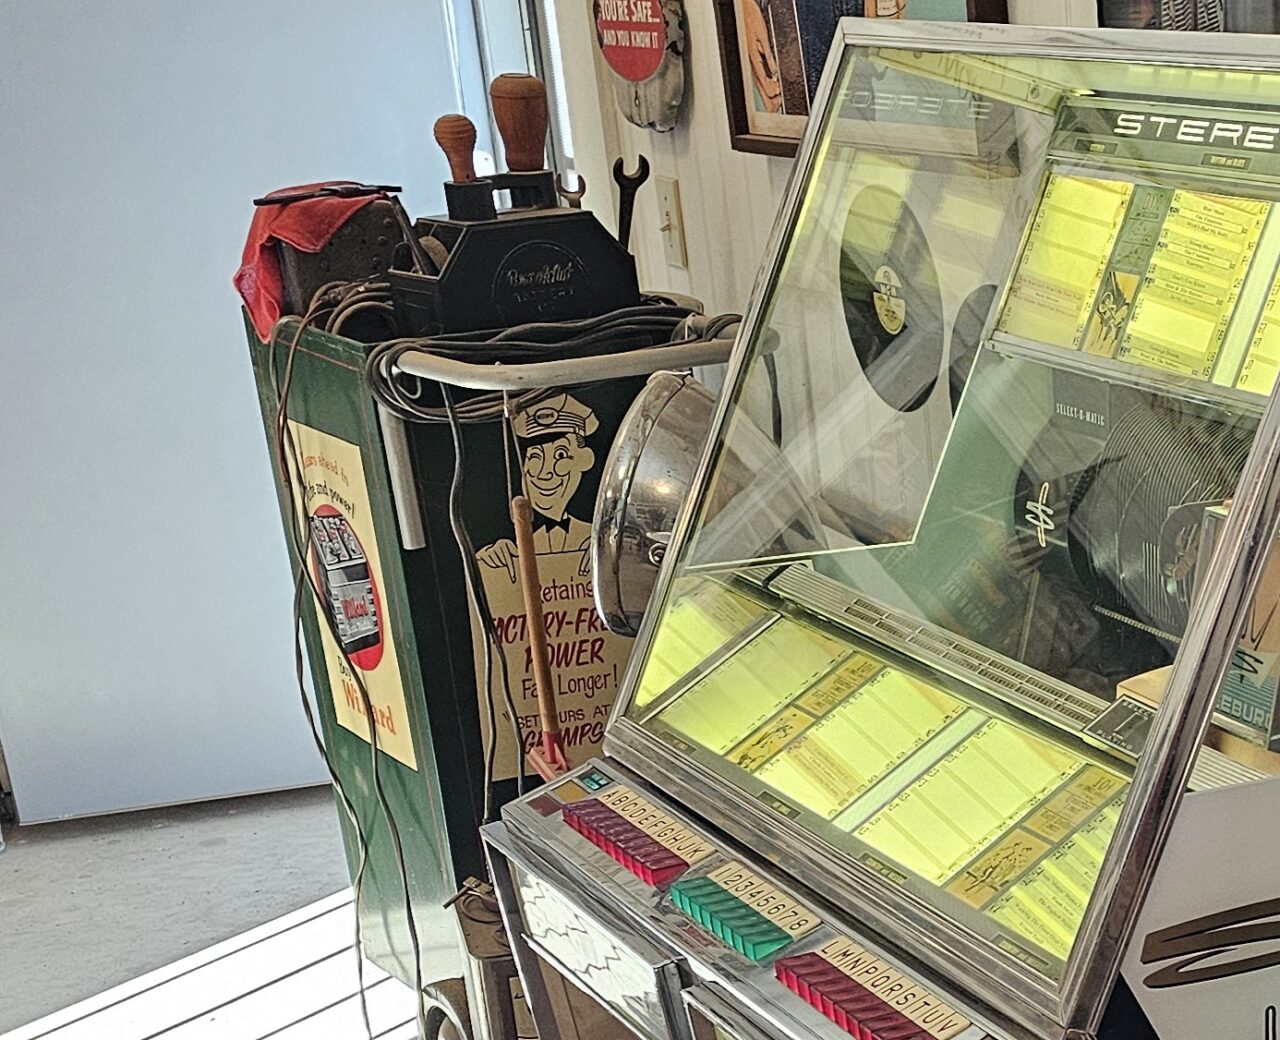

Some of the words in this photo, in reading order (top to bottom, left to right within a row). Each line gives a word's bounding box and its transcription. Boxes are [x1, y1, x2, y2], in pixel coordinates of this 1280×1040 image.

[603, 29, 616, 46] AND
[616, 30, 629, 47] YOU
[630, 31, 650, 48] KNOW
[651, 32, 659, 48] IT
[316, 480, 329, 496] and
[329, 488, 355, 519] power!
[522, 679, 538, 700] Fa
[557, 664, 618, 699] Longer!
[593, 704, 610, 718] AT
[603, 789, 616, 801] A
[612, 794, 626, 806] B
[621, 802, 637, 813] C
[630, 808, 646, 819] D
[637, 814, 651, 825] E
[649, 820, 662, 830] F
[715, 867, 732, 878] 1
[723, 874, 743, 886] 2
[735, 881, 754, 892] 3
[748, 889, 764, 899] 4
[756, 896, 776, 907] 5
[767, 903, 786, 915] 6
[778, 910, 798, 922] 7
[789, 919, 809, 931] 8
[821, 941, 840, 955] L
